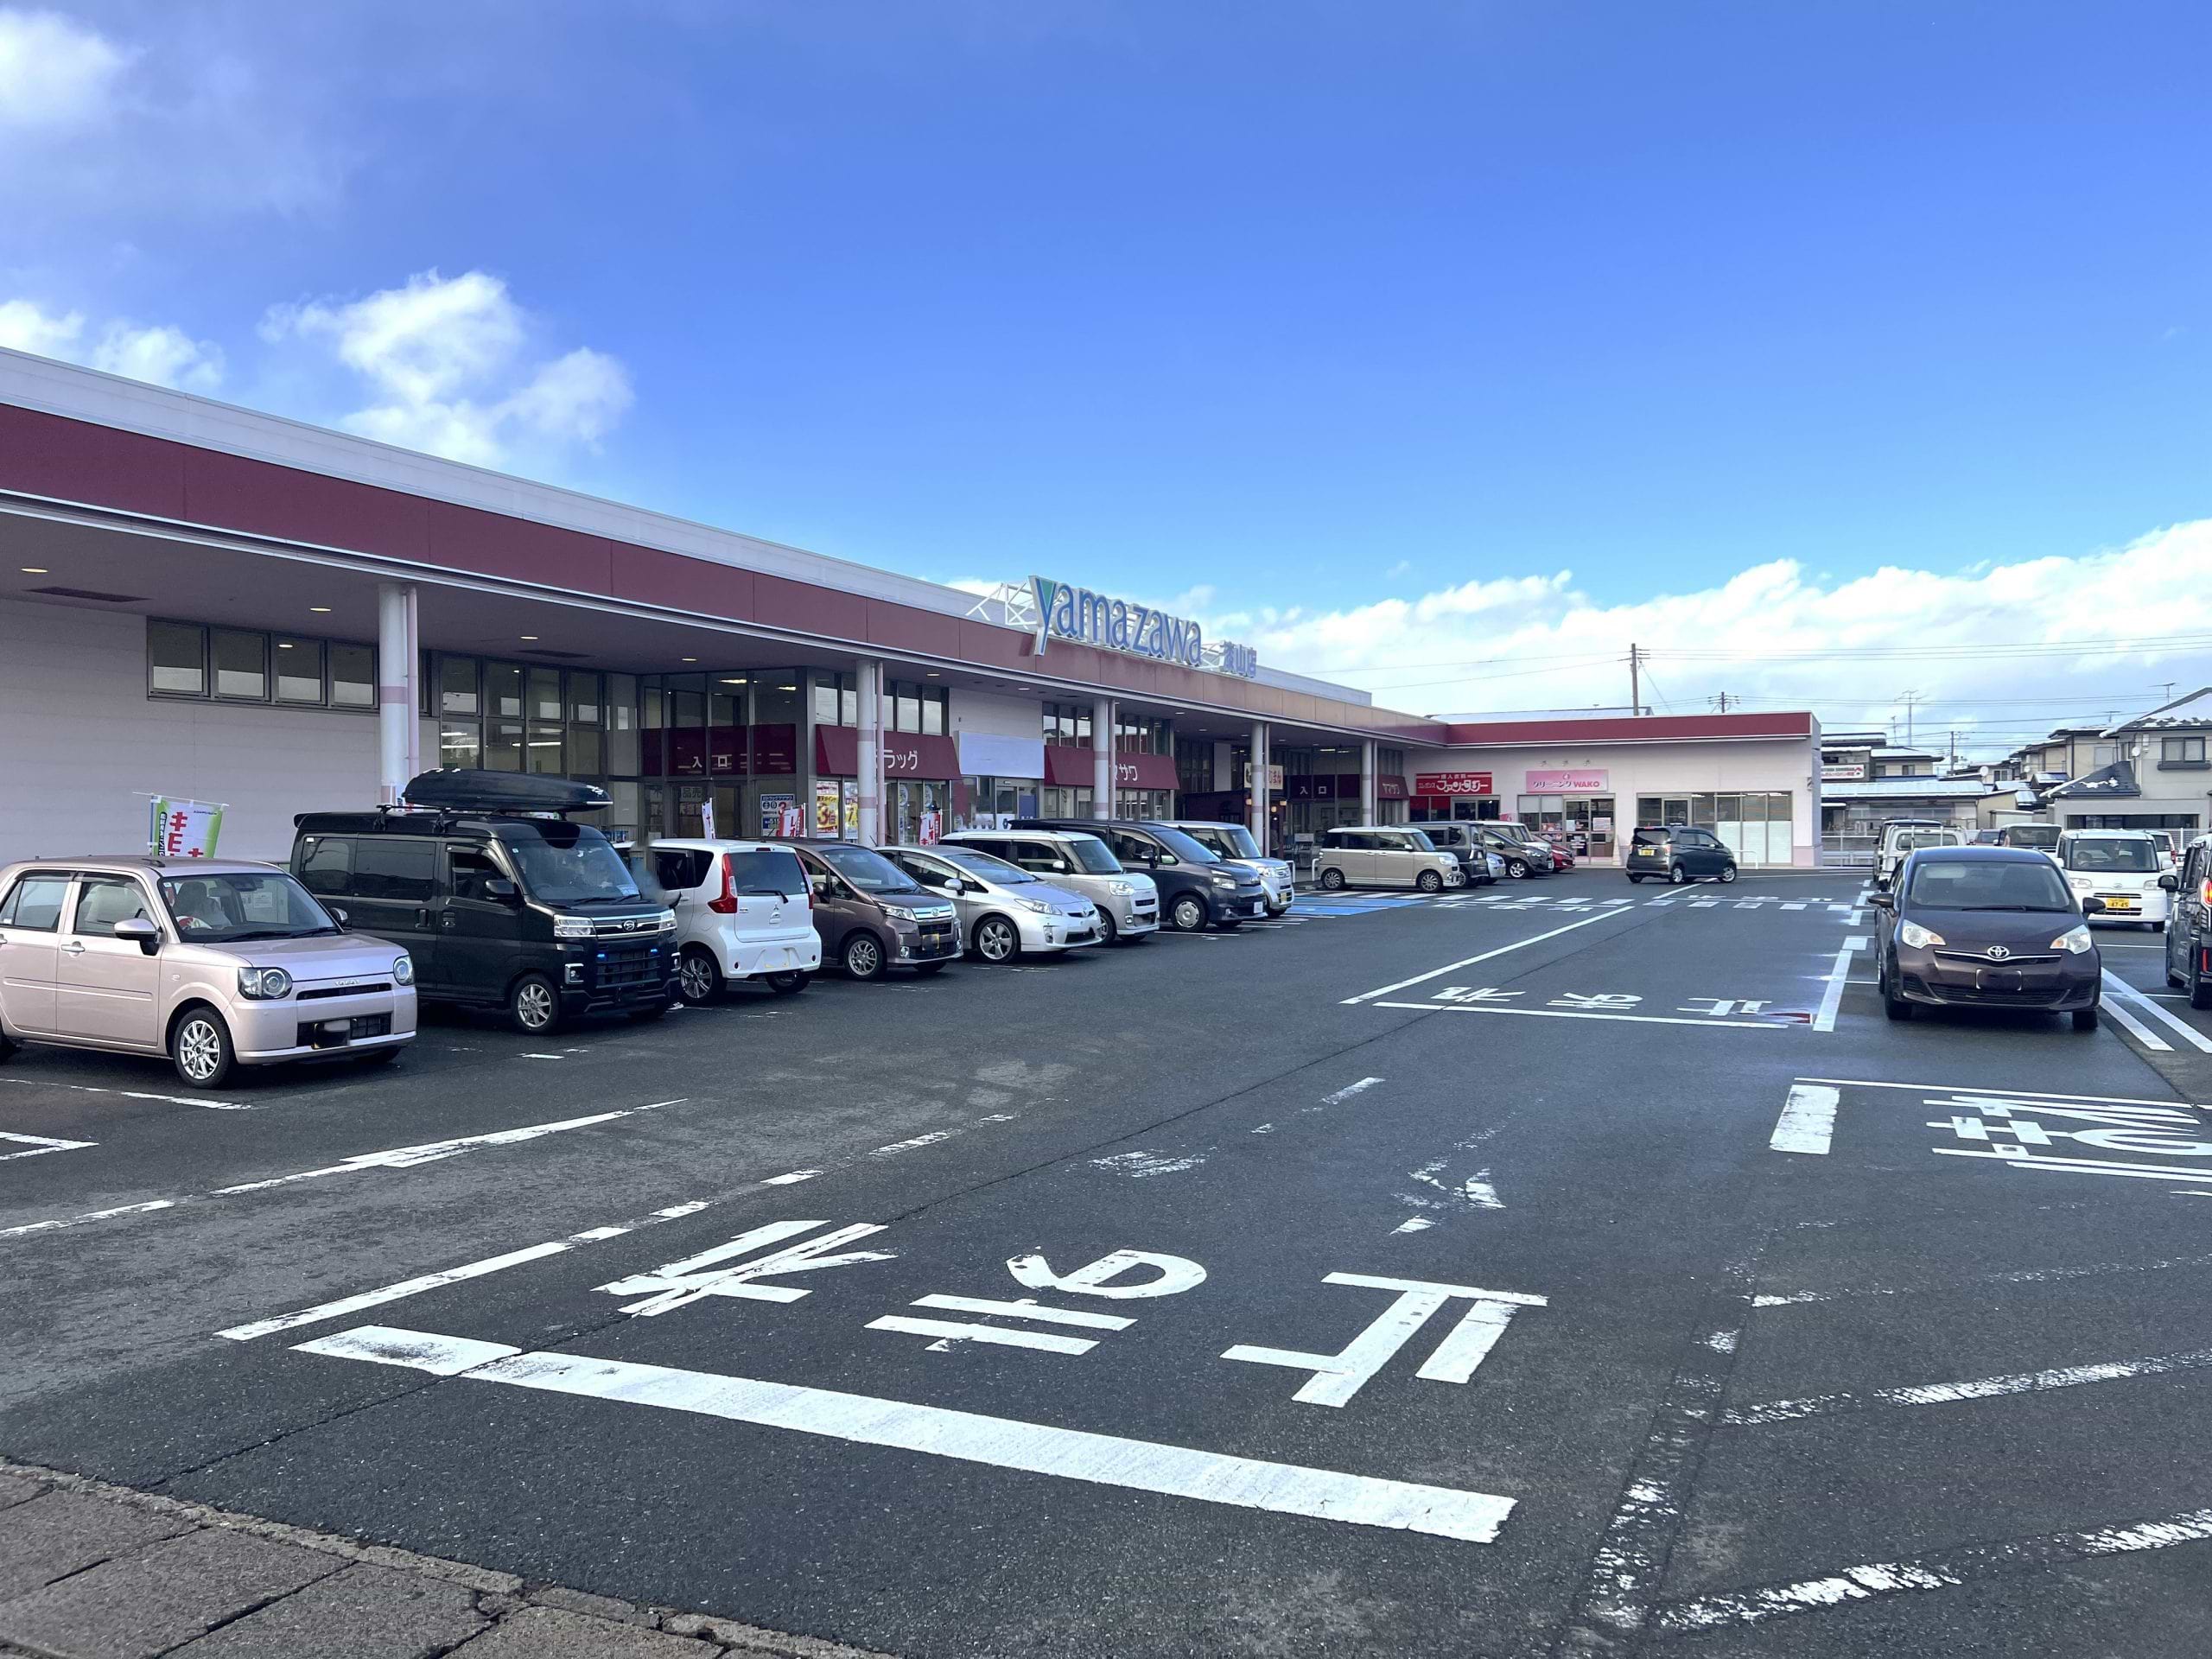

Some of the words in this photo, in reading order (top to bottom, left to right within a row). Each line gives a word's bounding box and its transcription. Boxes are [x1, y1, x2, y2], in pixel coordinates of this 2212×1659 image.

[1028, 575, 1203, 667] yamazawa
[692, 755, 728, 768] 入口
[875, 749, 918, 770] ラッグ
[1300, 785, 1327, 795] 入口
[1431, 985, 1773, 1017] 止まれ
[592, 1220, 1548, 1408] 止まれ
